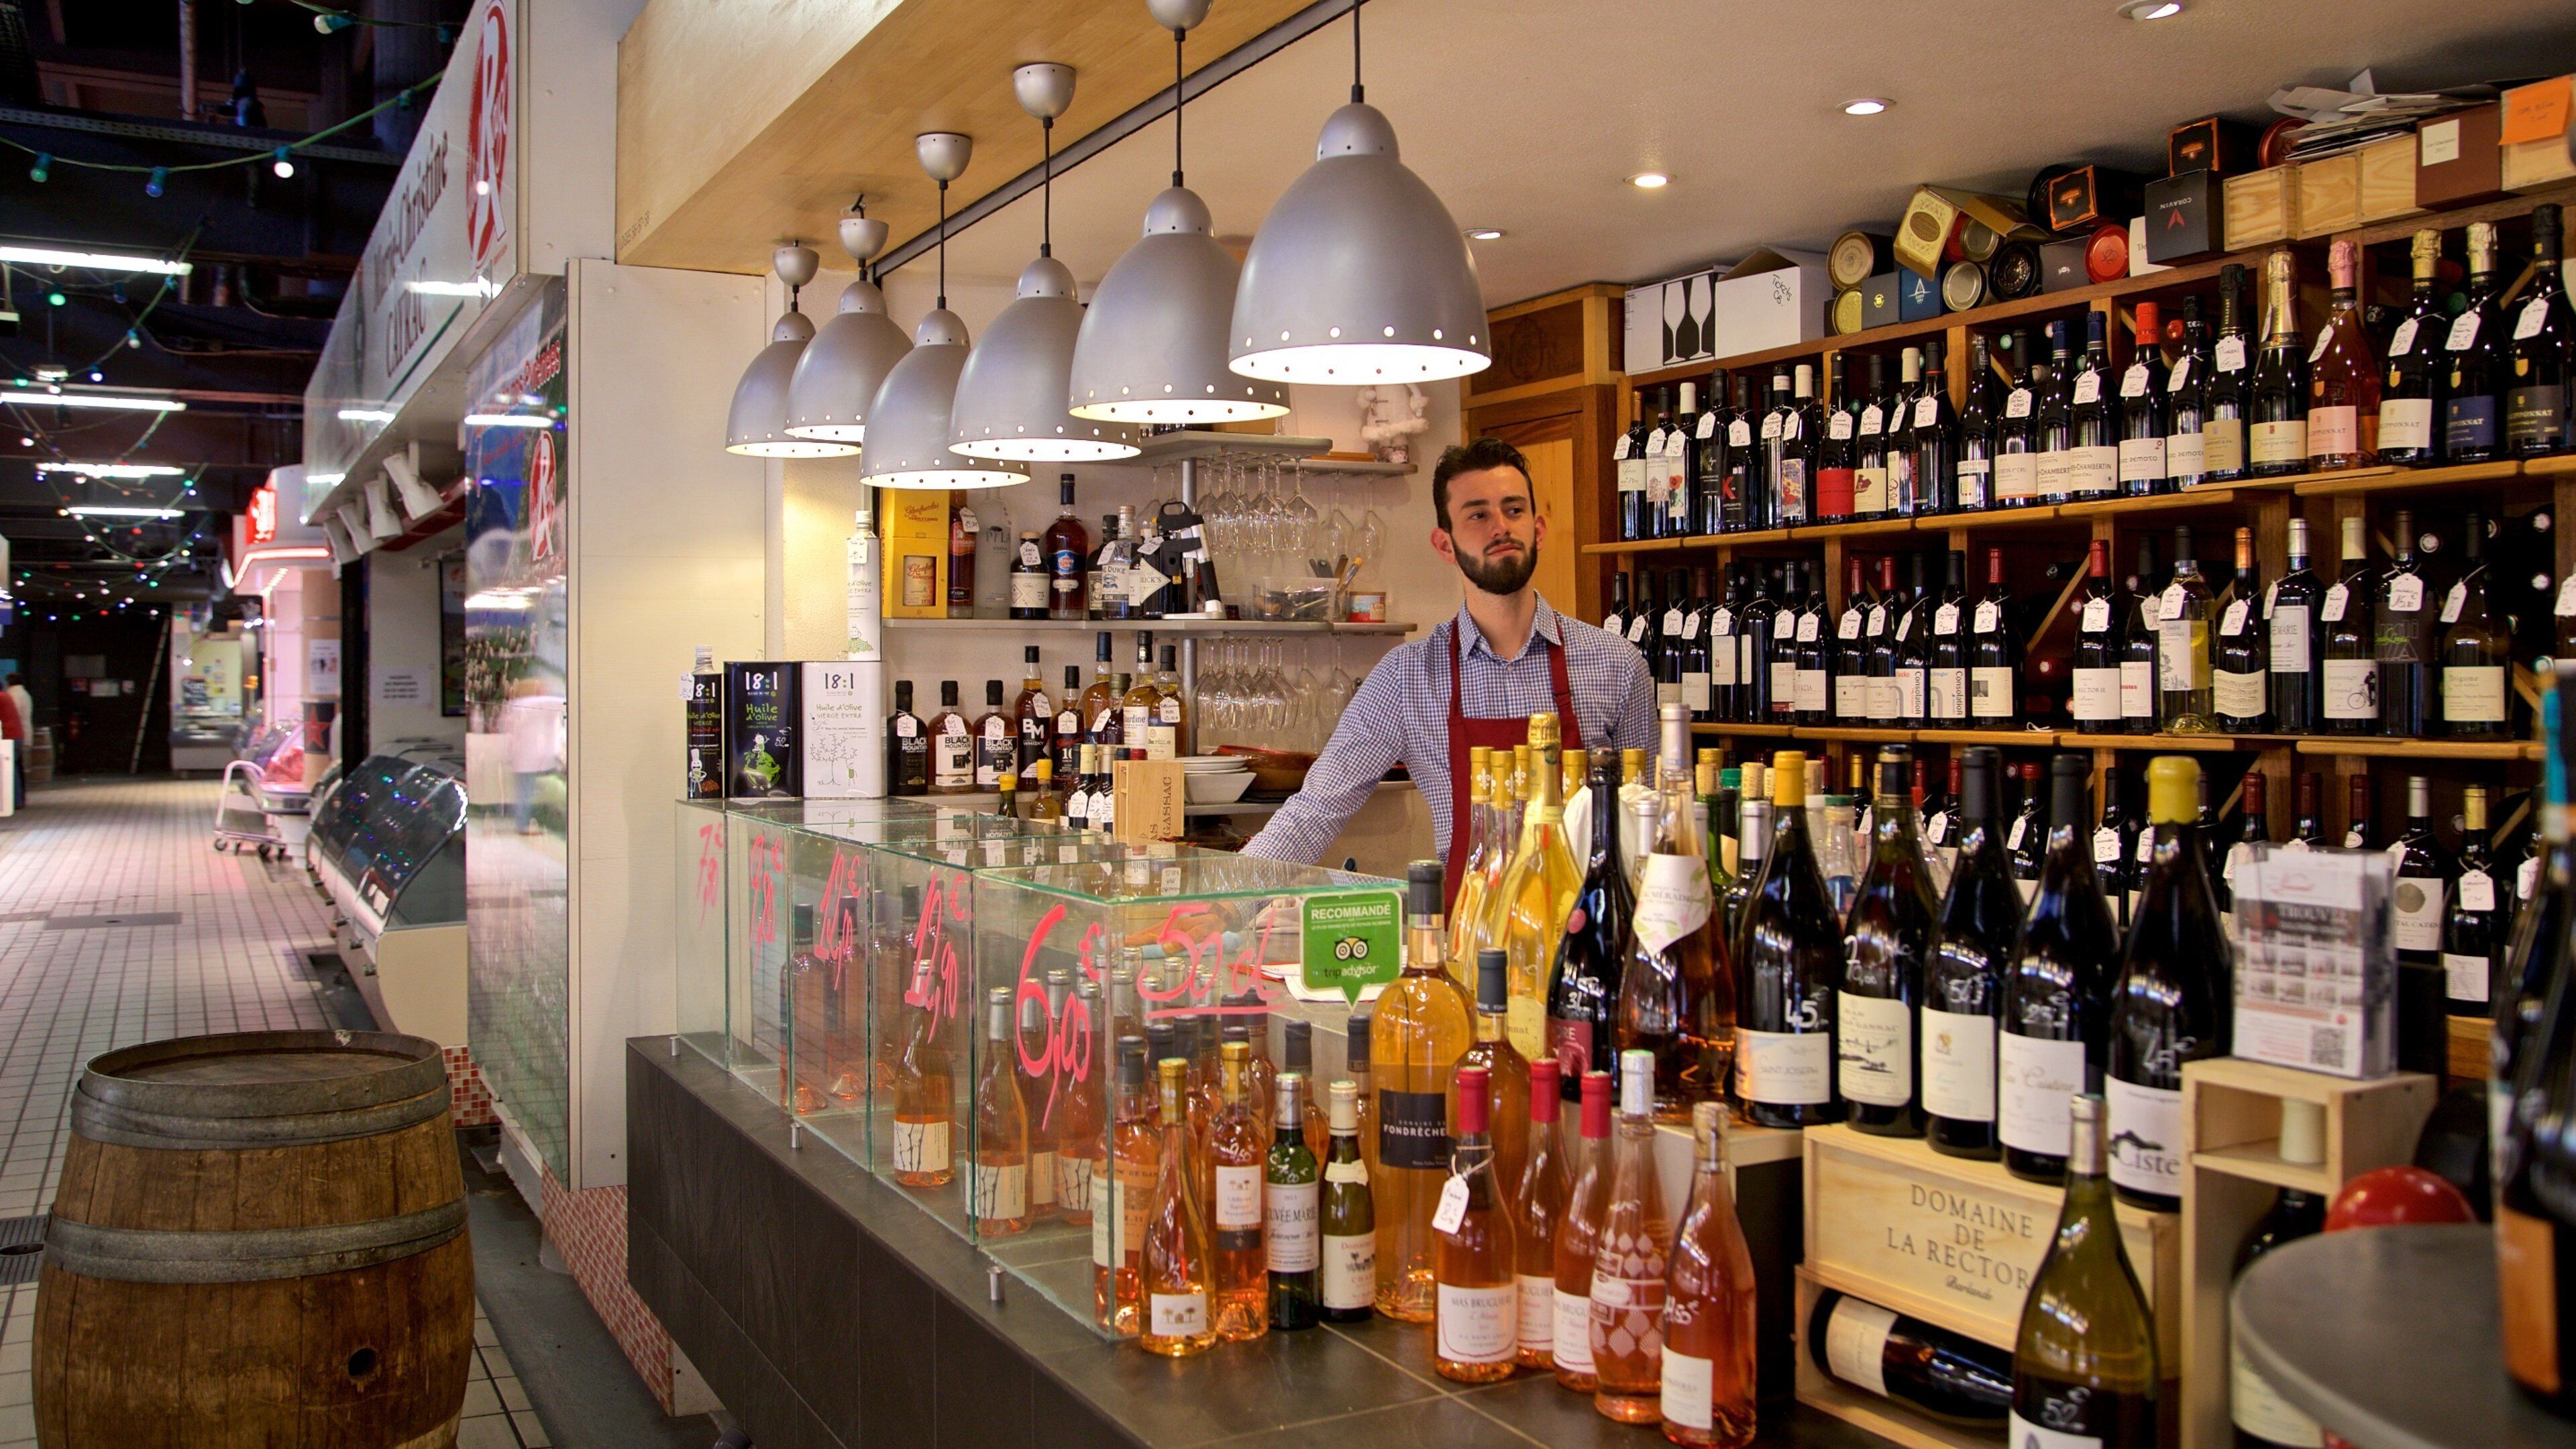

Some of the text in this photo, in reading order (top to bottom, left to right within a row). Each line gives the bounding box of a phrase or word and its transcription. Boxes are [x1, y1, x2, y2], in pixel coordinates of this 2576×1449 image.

[2159, 197, 2192, 210] CORAVIN
[2253, 438, 2299, 451] Charpentier
[1108, 566, 1126, 575] DUKE
[745, 671, 778, 690] 18:1
[825, 673, 854, 690] 18:1
[1915, 671, 1923, 715] Consolation
[1955, 670, 1964, 716] Consolation
[745, 702, 778, 713] Huile
[816, 703, 863, 712] Huile d'Olive
[745, 712, 778, 721] d'Olive
[1022, 718, 1044, 739] BM
[902, 737, 927, 745] BLACK
[945, 736, 971, 744] BLACK
[985, 739, 1013, 747] BLACK
[1163, 775, 1172, 836] GASSAC
[1311, 902, 1391, 920] RECOMMANDÉ
[1136, 903, 1224, 1002] 50
[1324, 965, 1377, 979] tripadvisor
[1911, 1184, 2033, 1238] DOMAINE
[1955, 1222, 1986, 1252] DE
[1887, 1226, 2031, 1291] LA RECTOR
